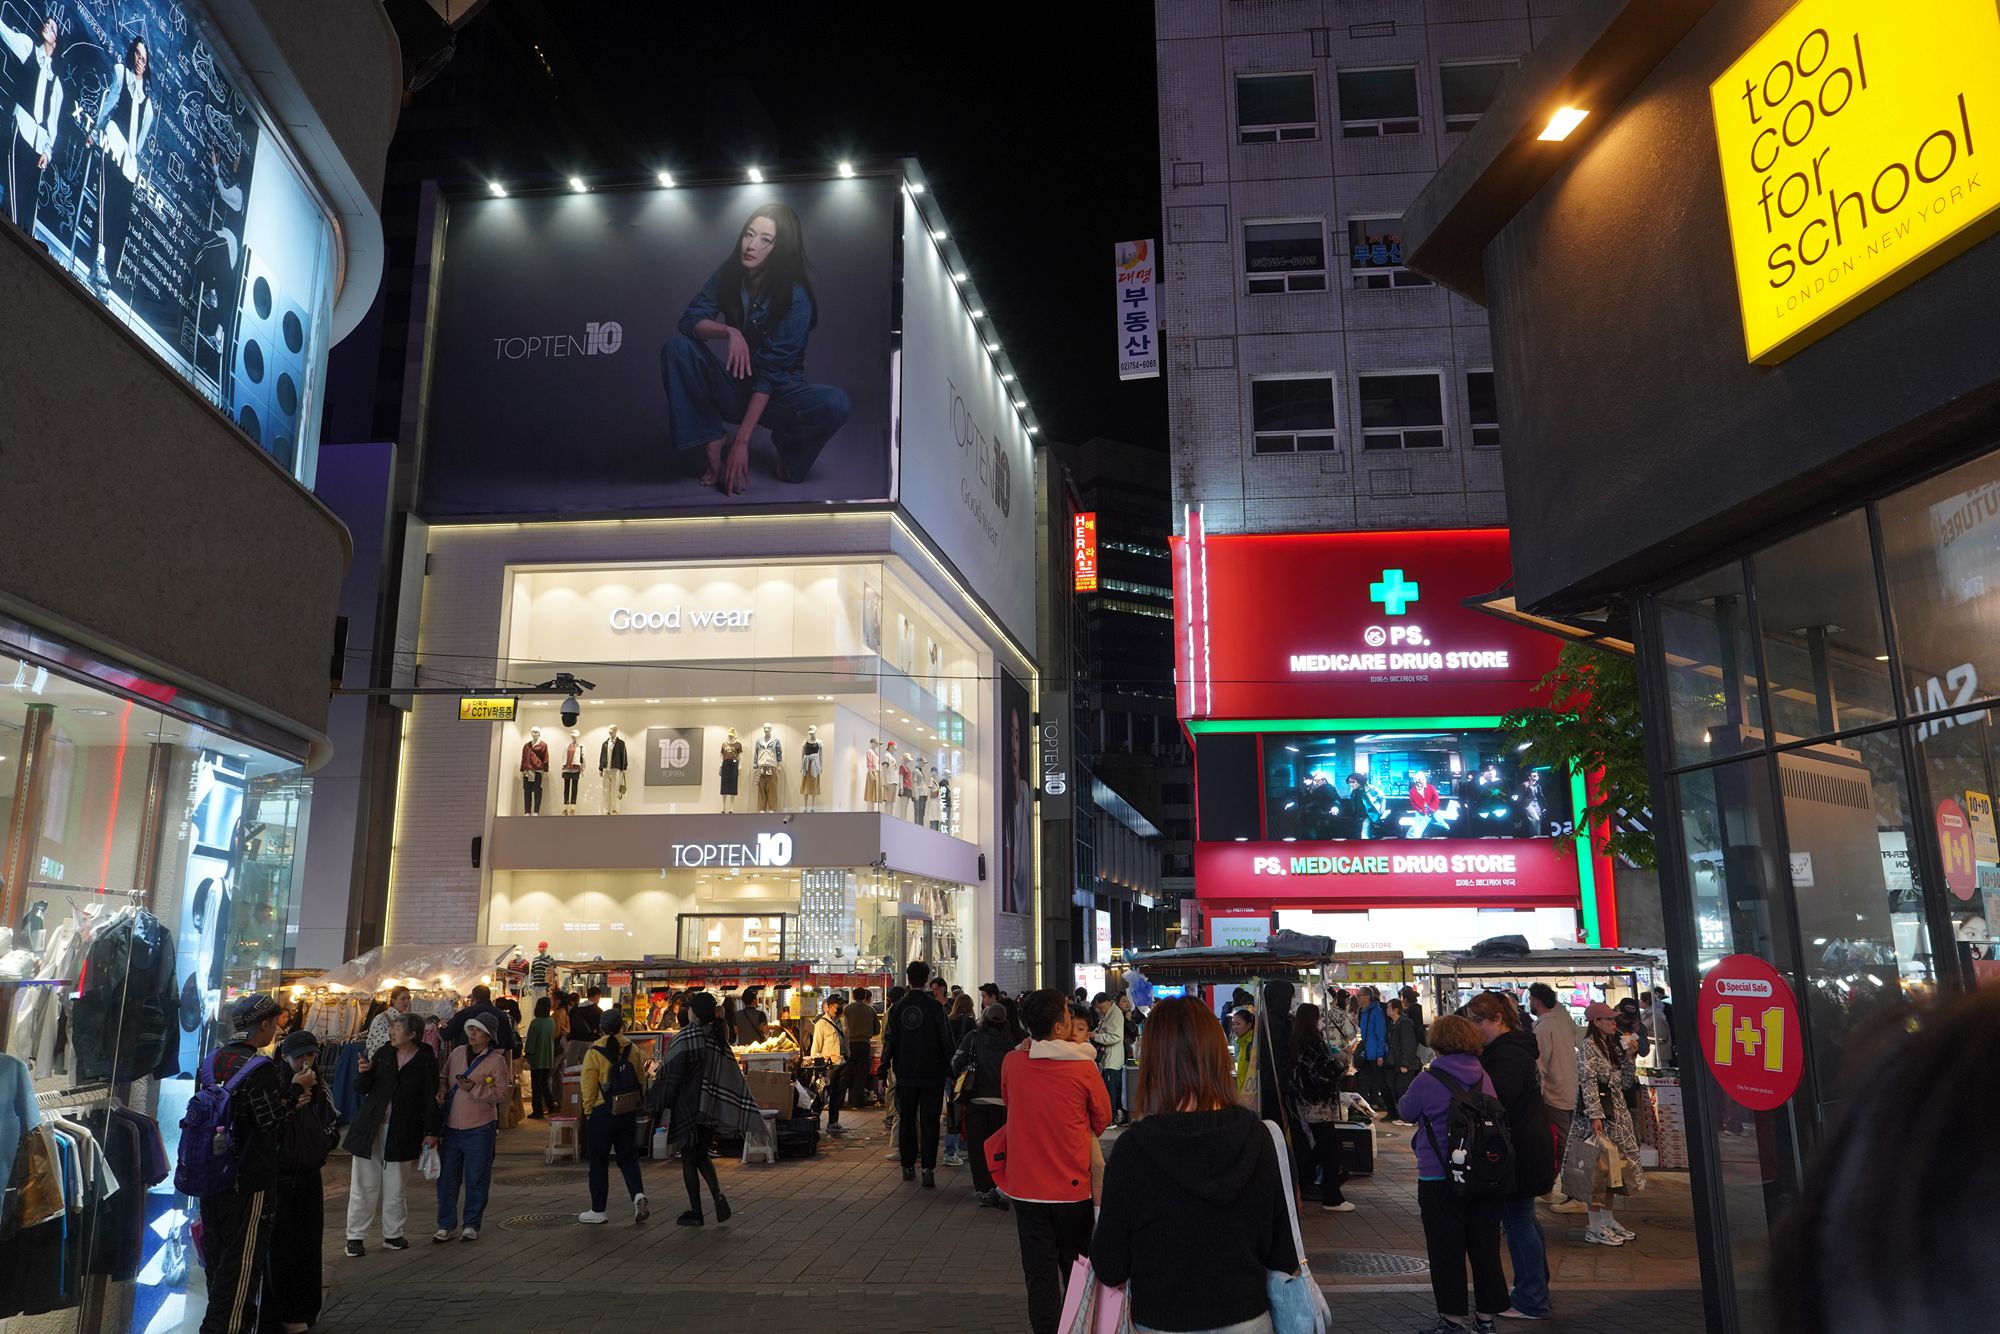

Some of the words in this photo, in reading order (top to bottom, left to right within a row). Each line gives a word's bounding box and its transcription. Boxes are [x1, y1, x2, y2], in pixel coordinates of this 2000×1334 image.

[1741, 28, 1829, 125] too
[1750, 32, 1867, 174] cool
[1757, 146, 1831, 234] for
[1767, 92, 1975, 289] school
[1918, 172, 1982, 224] YORK
[1123, 287, 1151, 357] 부동산
[1120, 360, 1156, 371] 02)754-6065
[961, 478, 982, 525] Good
[983, 511, 999, 548] wear
[1075, 516, 1086, 560] HERA
[609, 604, 681, 630] Good
[689, 608, 754, 627] wear
[1390, 626, 1430, 646] PS.
[1290, 653, 1387, 671] MEDICARE
[1390, 652, 1442, 670] DRUG
[1446, 650, 1509, 668] STORE
[659, 738, 690, 768] 10
[1969, 797, 1989, 815] 10+10
[672, 832, 793, 867] TOPTEN10
[1254, 857, 1286, 875] PS.
[1290, 856, 1389, 875] MEDICARE
[1393, 855, 1448, 873] DRUG
[1451, 854, 1516, 873] STORE
[1942, 830, 1972, 876] 1+1
[1726, 982, 1751, 993] Special
[1752, 984, 1768, 993] Sale
[1713, 1004, 1784, 1072] 1+1
